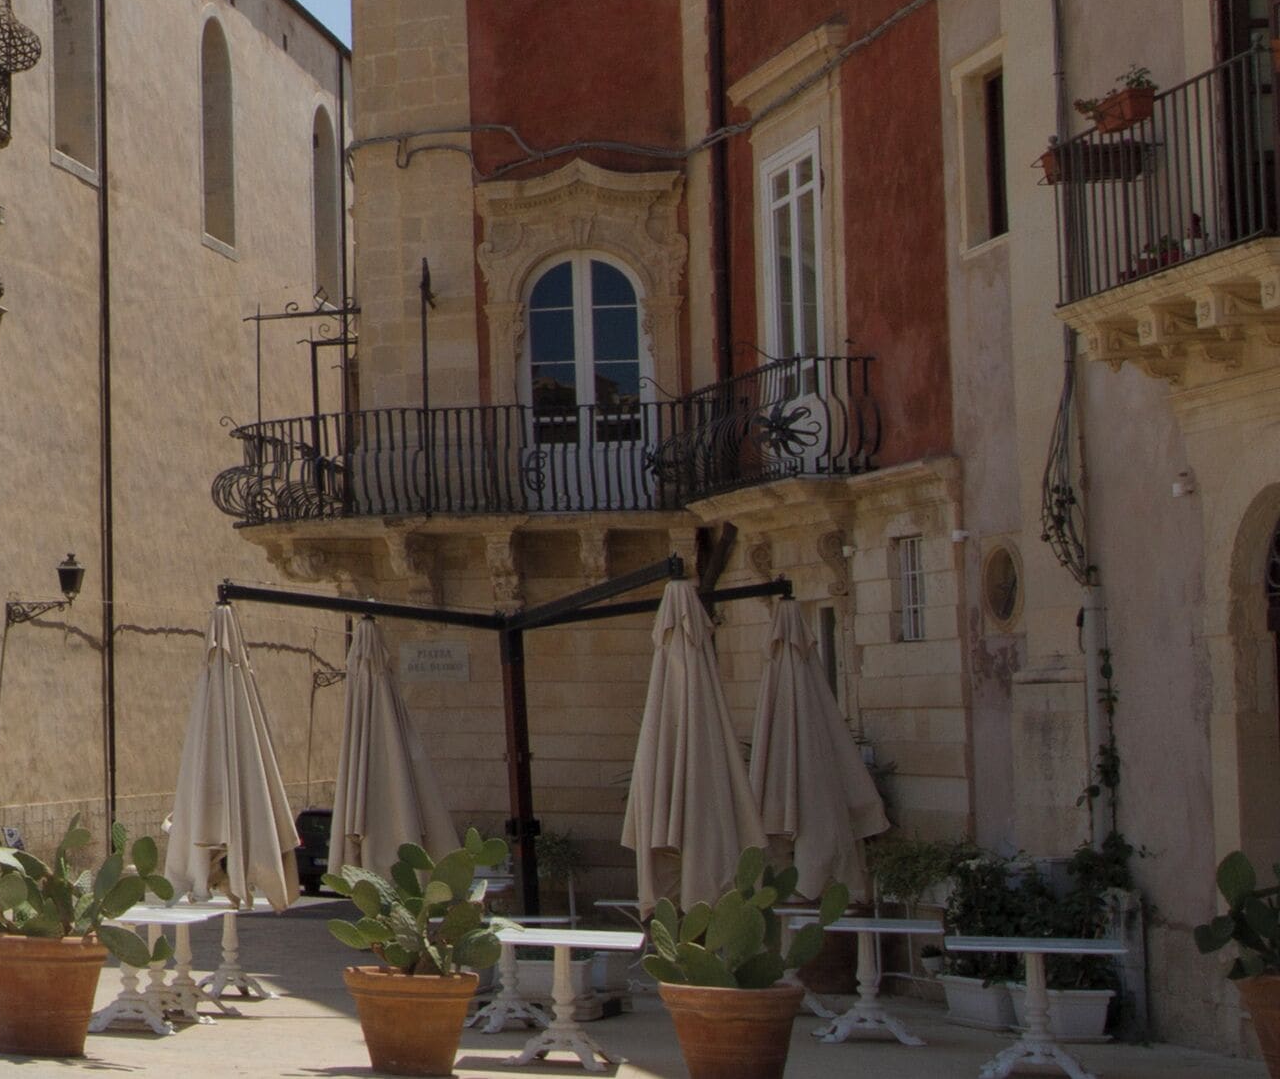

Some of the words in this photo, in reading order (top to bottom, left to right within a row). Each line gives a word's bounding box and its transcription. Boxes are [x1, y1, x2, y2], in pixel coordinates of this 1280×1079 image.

[416, 647, 452, 660] PIAZZA
[407, 661, 425, 674] DEL
[428, 661, 464, 673] DUOMO
